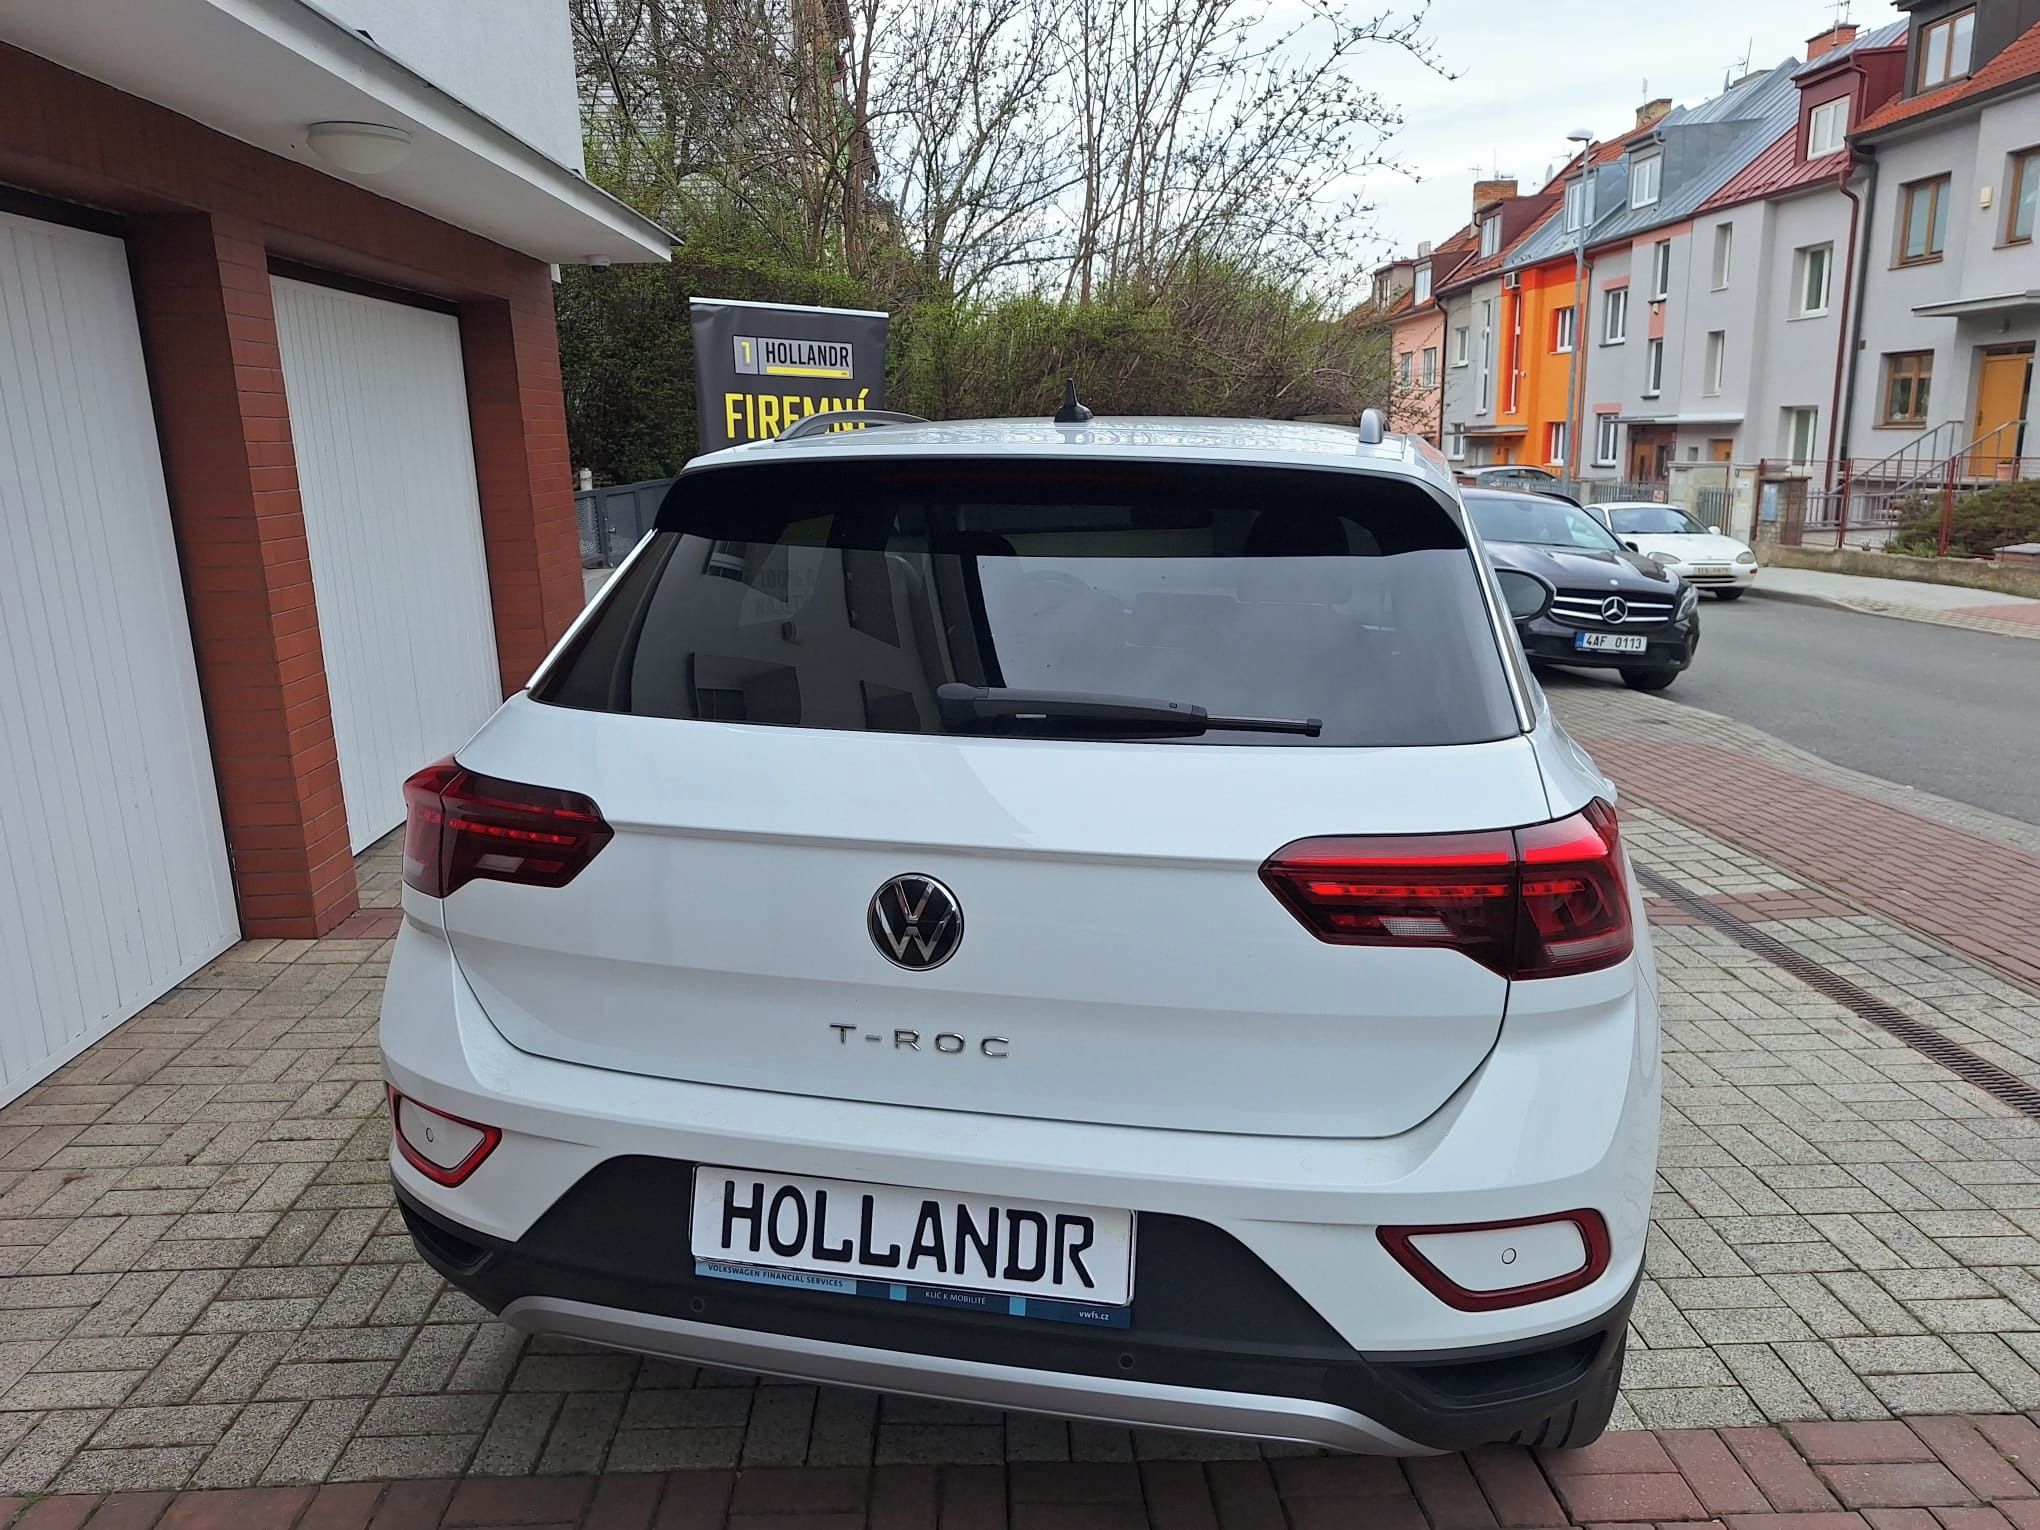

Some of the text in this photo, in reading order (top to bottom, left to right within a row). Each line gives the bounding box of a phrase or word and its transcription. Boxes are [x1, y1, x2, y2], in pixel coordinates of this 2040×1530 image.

[741, 341, 850, 367] 1 HOLLANDR
[1586, 634, 1608, 647] 4AF
[1615, 637, 1642, 649] 0113
[873, 878, 957, 963] VW
[830, 1023, 1009, 1058] T-ROC
[720, 1180, 1095, 1289] HOLLANDR
[707, 1264, 844, 1288] VOLKSWAGEN FINANCIAL SERVICES
[1079, 1310, 1110, 1321] vwfs.cz
